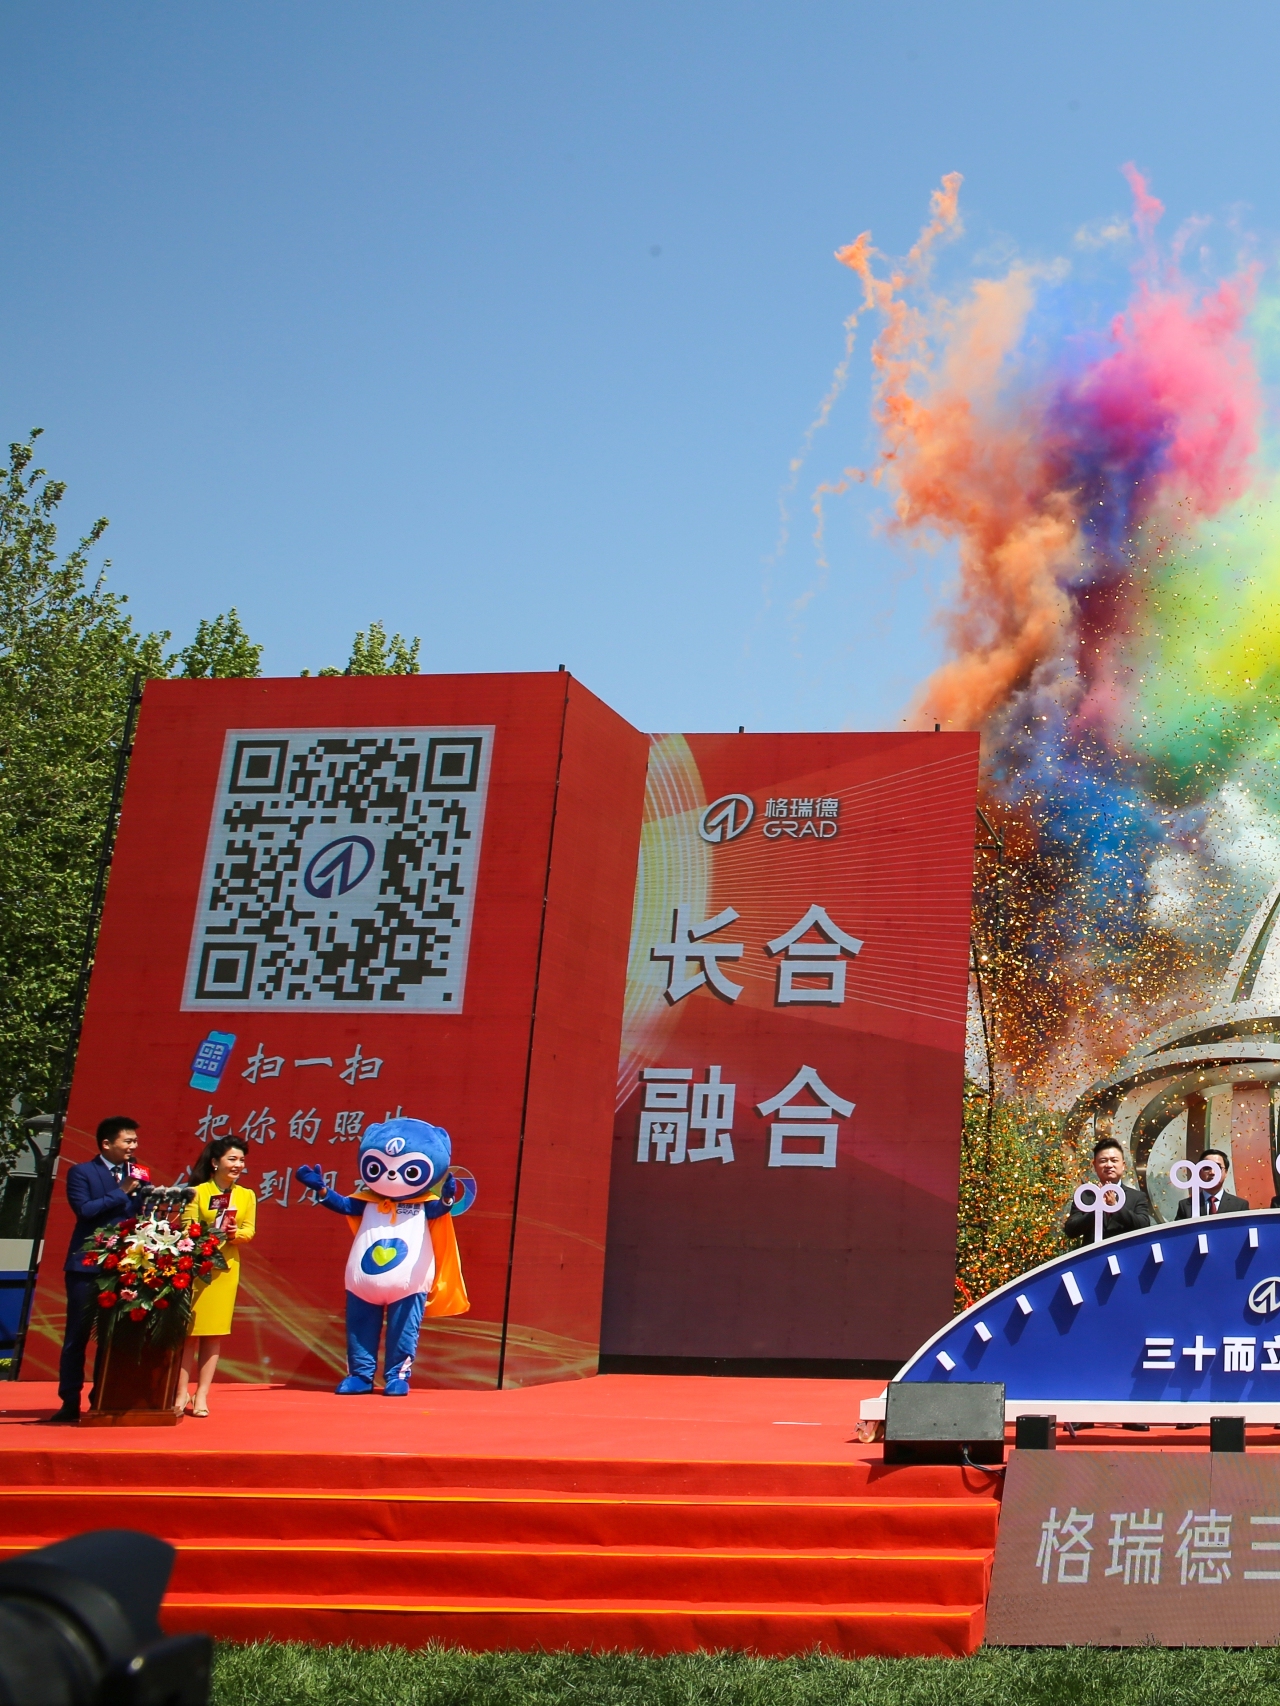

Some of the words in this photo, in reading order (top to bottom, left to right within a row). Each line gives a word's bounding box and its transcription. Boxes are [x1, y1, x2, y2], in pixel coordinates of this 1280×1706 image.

[762, 820, 838, 838] GRAD
[764, 797, 839, 818] 格瑞德
[653, 903, 865, 1004] 长合
[241, 1042, 384, 1085] 扫一扫
[636, 1064, 857, 1168] 融合
